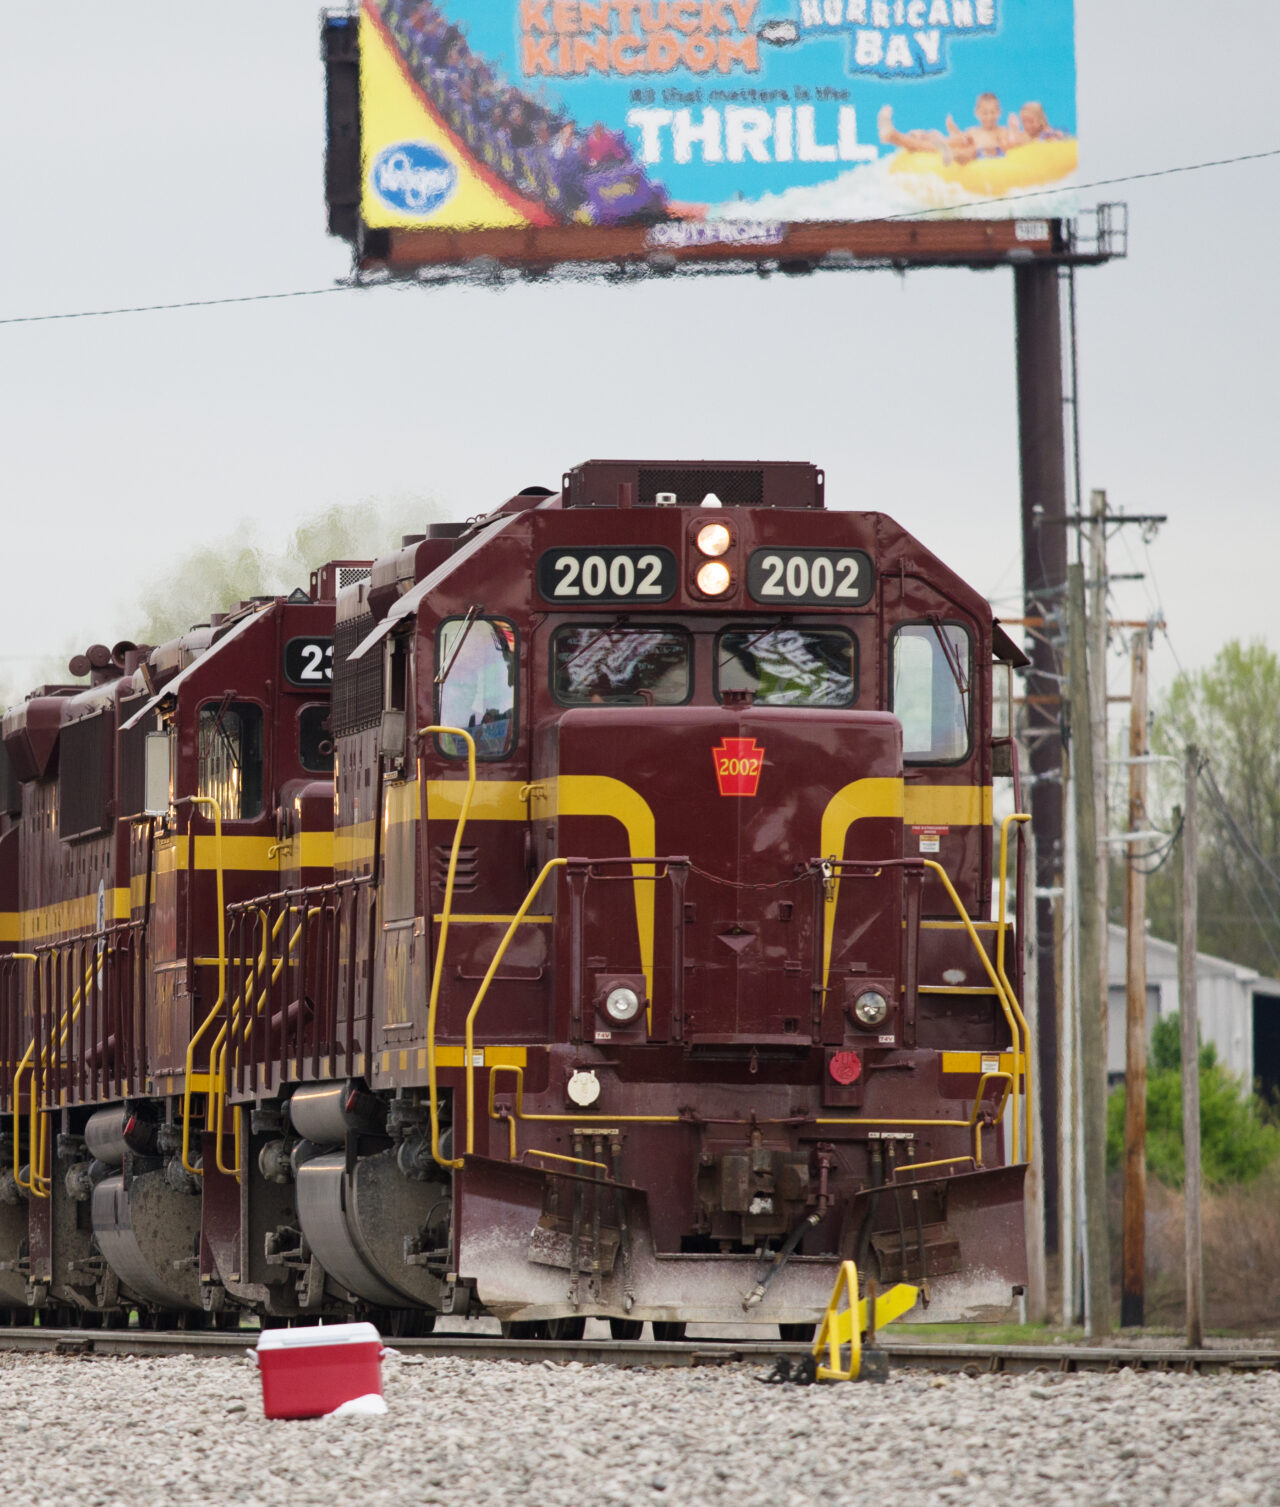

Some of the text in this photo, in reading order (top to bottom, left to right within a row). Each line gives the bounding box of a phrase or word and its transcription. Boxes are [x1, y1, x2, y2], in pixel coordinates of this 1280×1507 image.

[522, 0, 756, 33] KENTUCKY
[800, 0, 995, 28] HURRICANE
[522, 34, 760, 77] KINGDOM
[855, 29, 941, 67] BAY
[627, 105, 878, 164] THRILL
[554, 555, 663, 596] 2002
[761, 556, 859, 598] 2002
[720, 758, 758, 776] 2002
